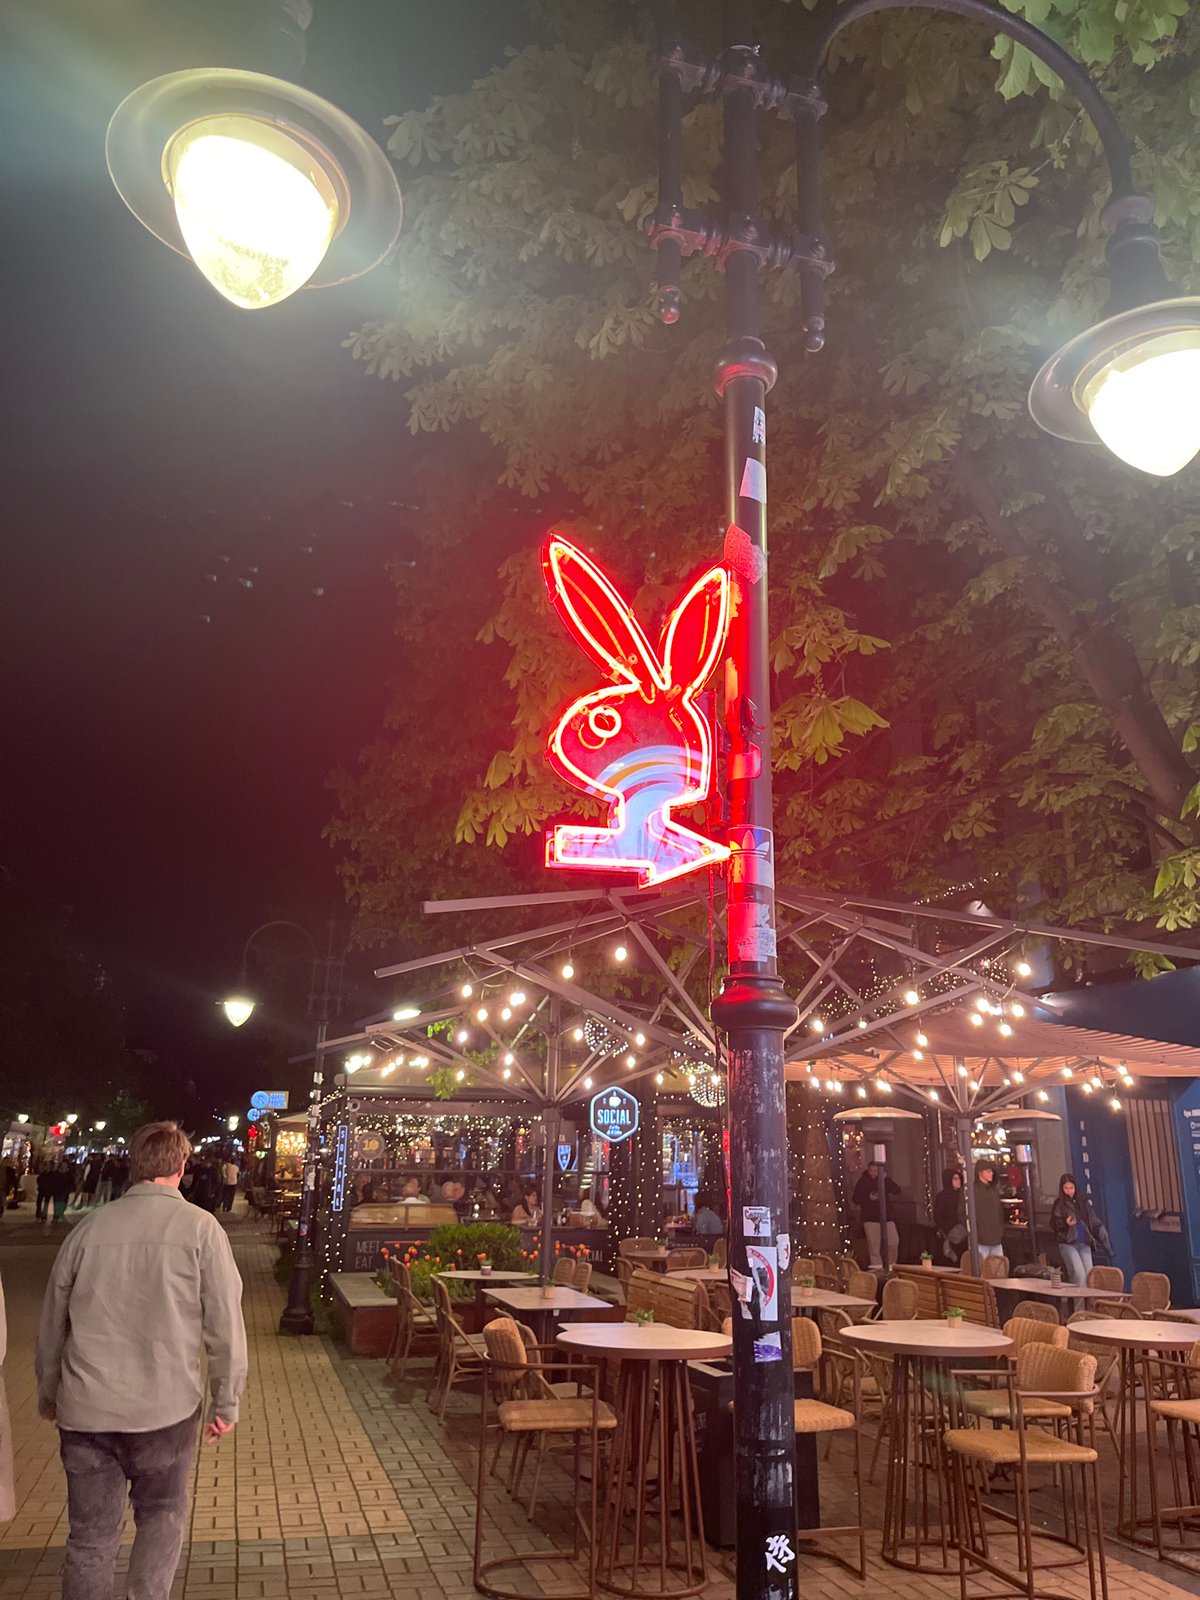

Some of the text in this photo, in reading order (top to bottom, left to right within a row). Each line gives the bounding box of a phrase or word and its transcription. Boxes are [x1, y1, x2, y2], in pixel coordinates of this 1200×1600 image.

[597, 1109, 632, 1125] SOCIAL
[335, 1130, 345, 1207] SOCIAL
[356, 1240, 380, 1253] MEET
[355, 1255, 373, 1269] EAT
